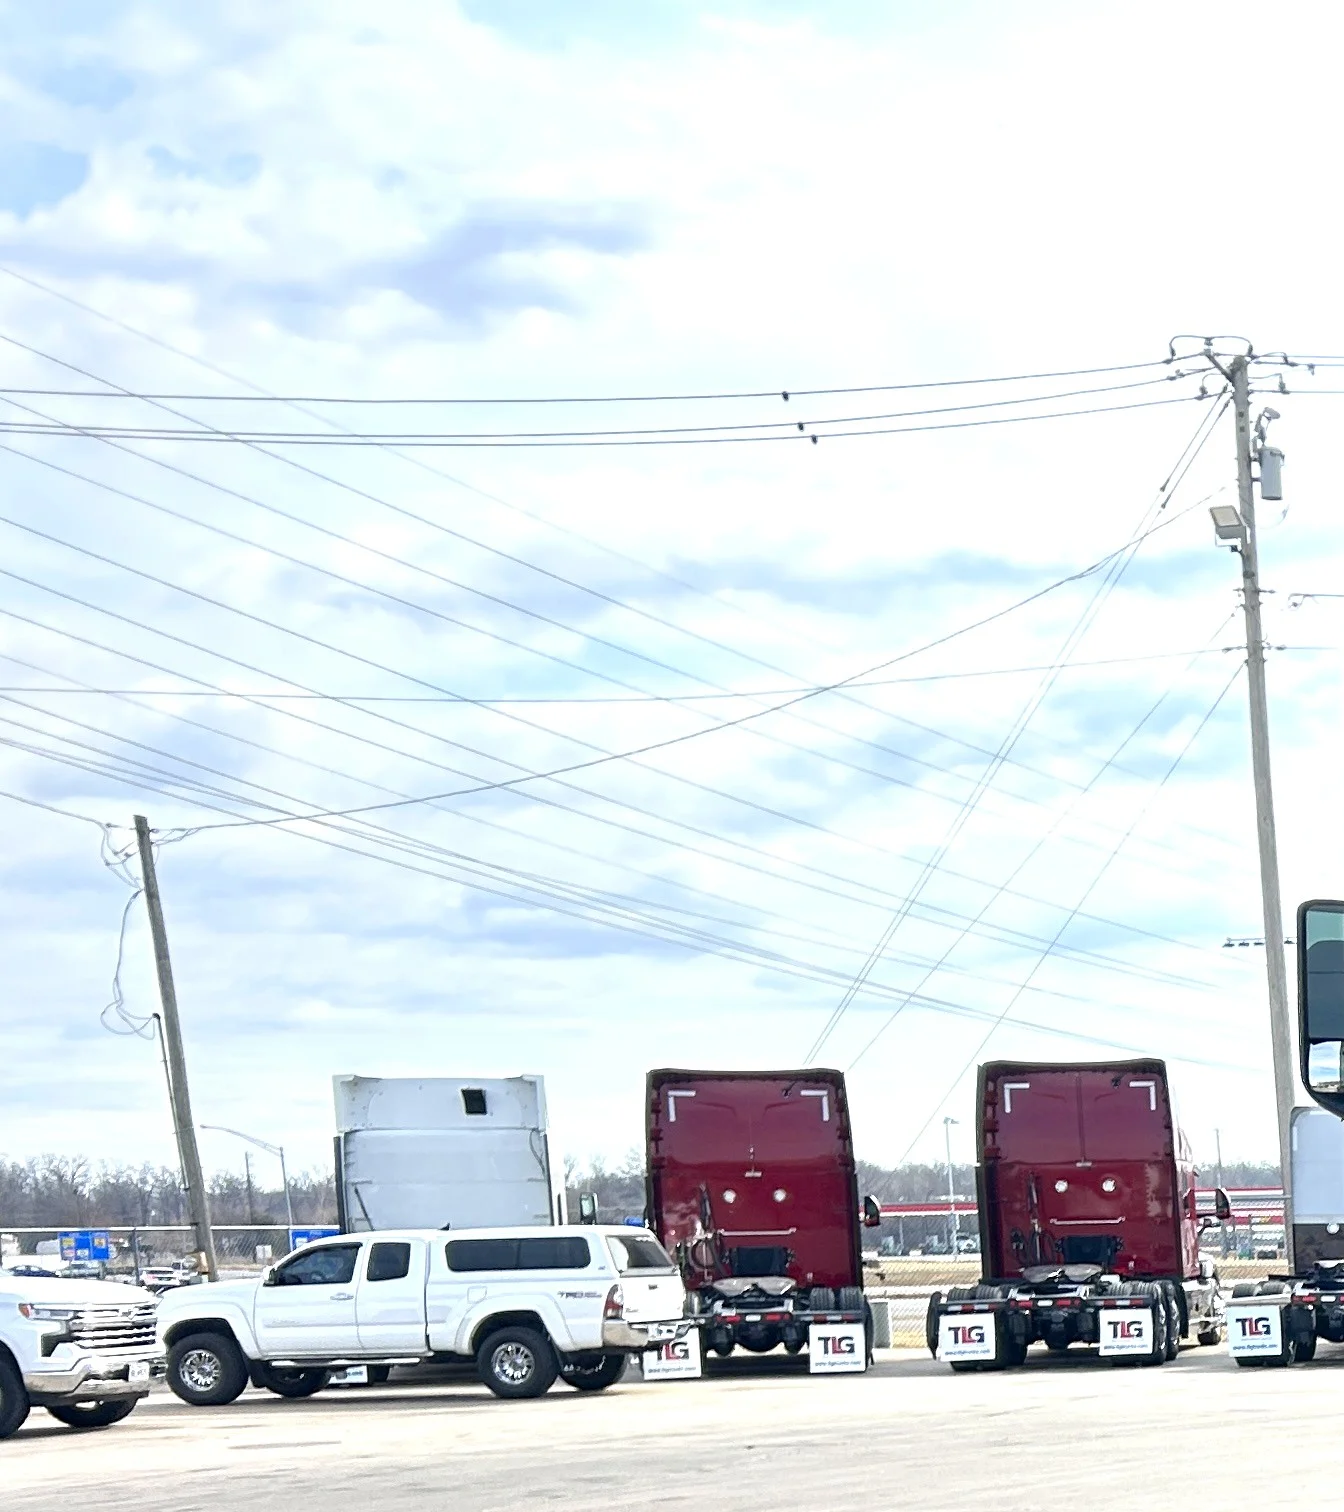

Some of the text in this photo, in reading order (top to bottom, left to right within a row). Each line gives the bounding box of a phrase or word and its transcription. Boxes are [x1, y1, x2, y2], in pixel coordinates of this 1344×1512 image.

[948, 1325, 985, 1345] TLG
[1107, 1320, 1144, 1339] TLG
[1235, 1316, 1272, 1337] TLG
[817, 1335, 855, 1355] TLG
